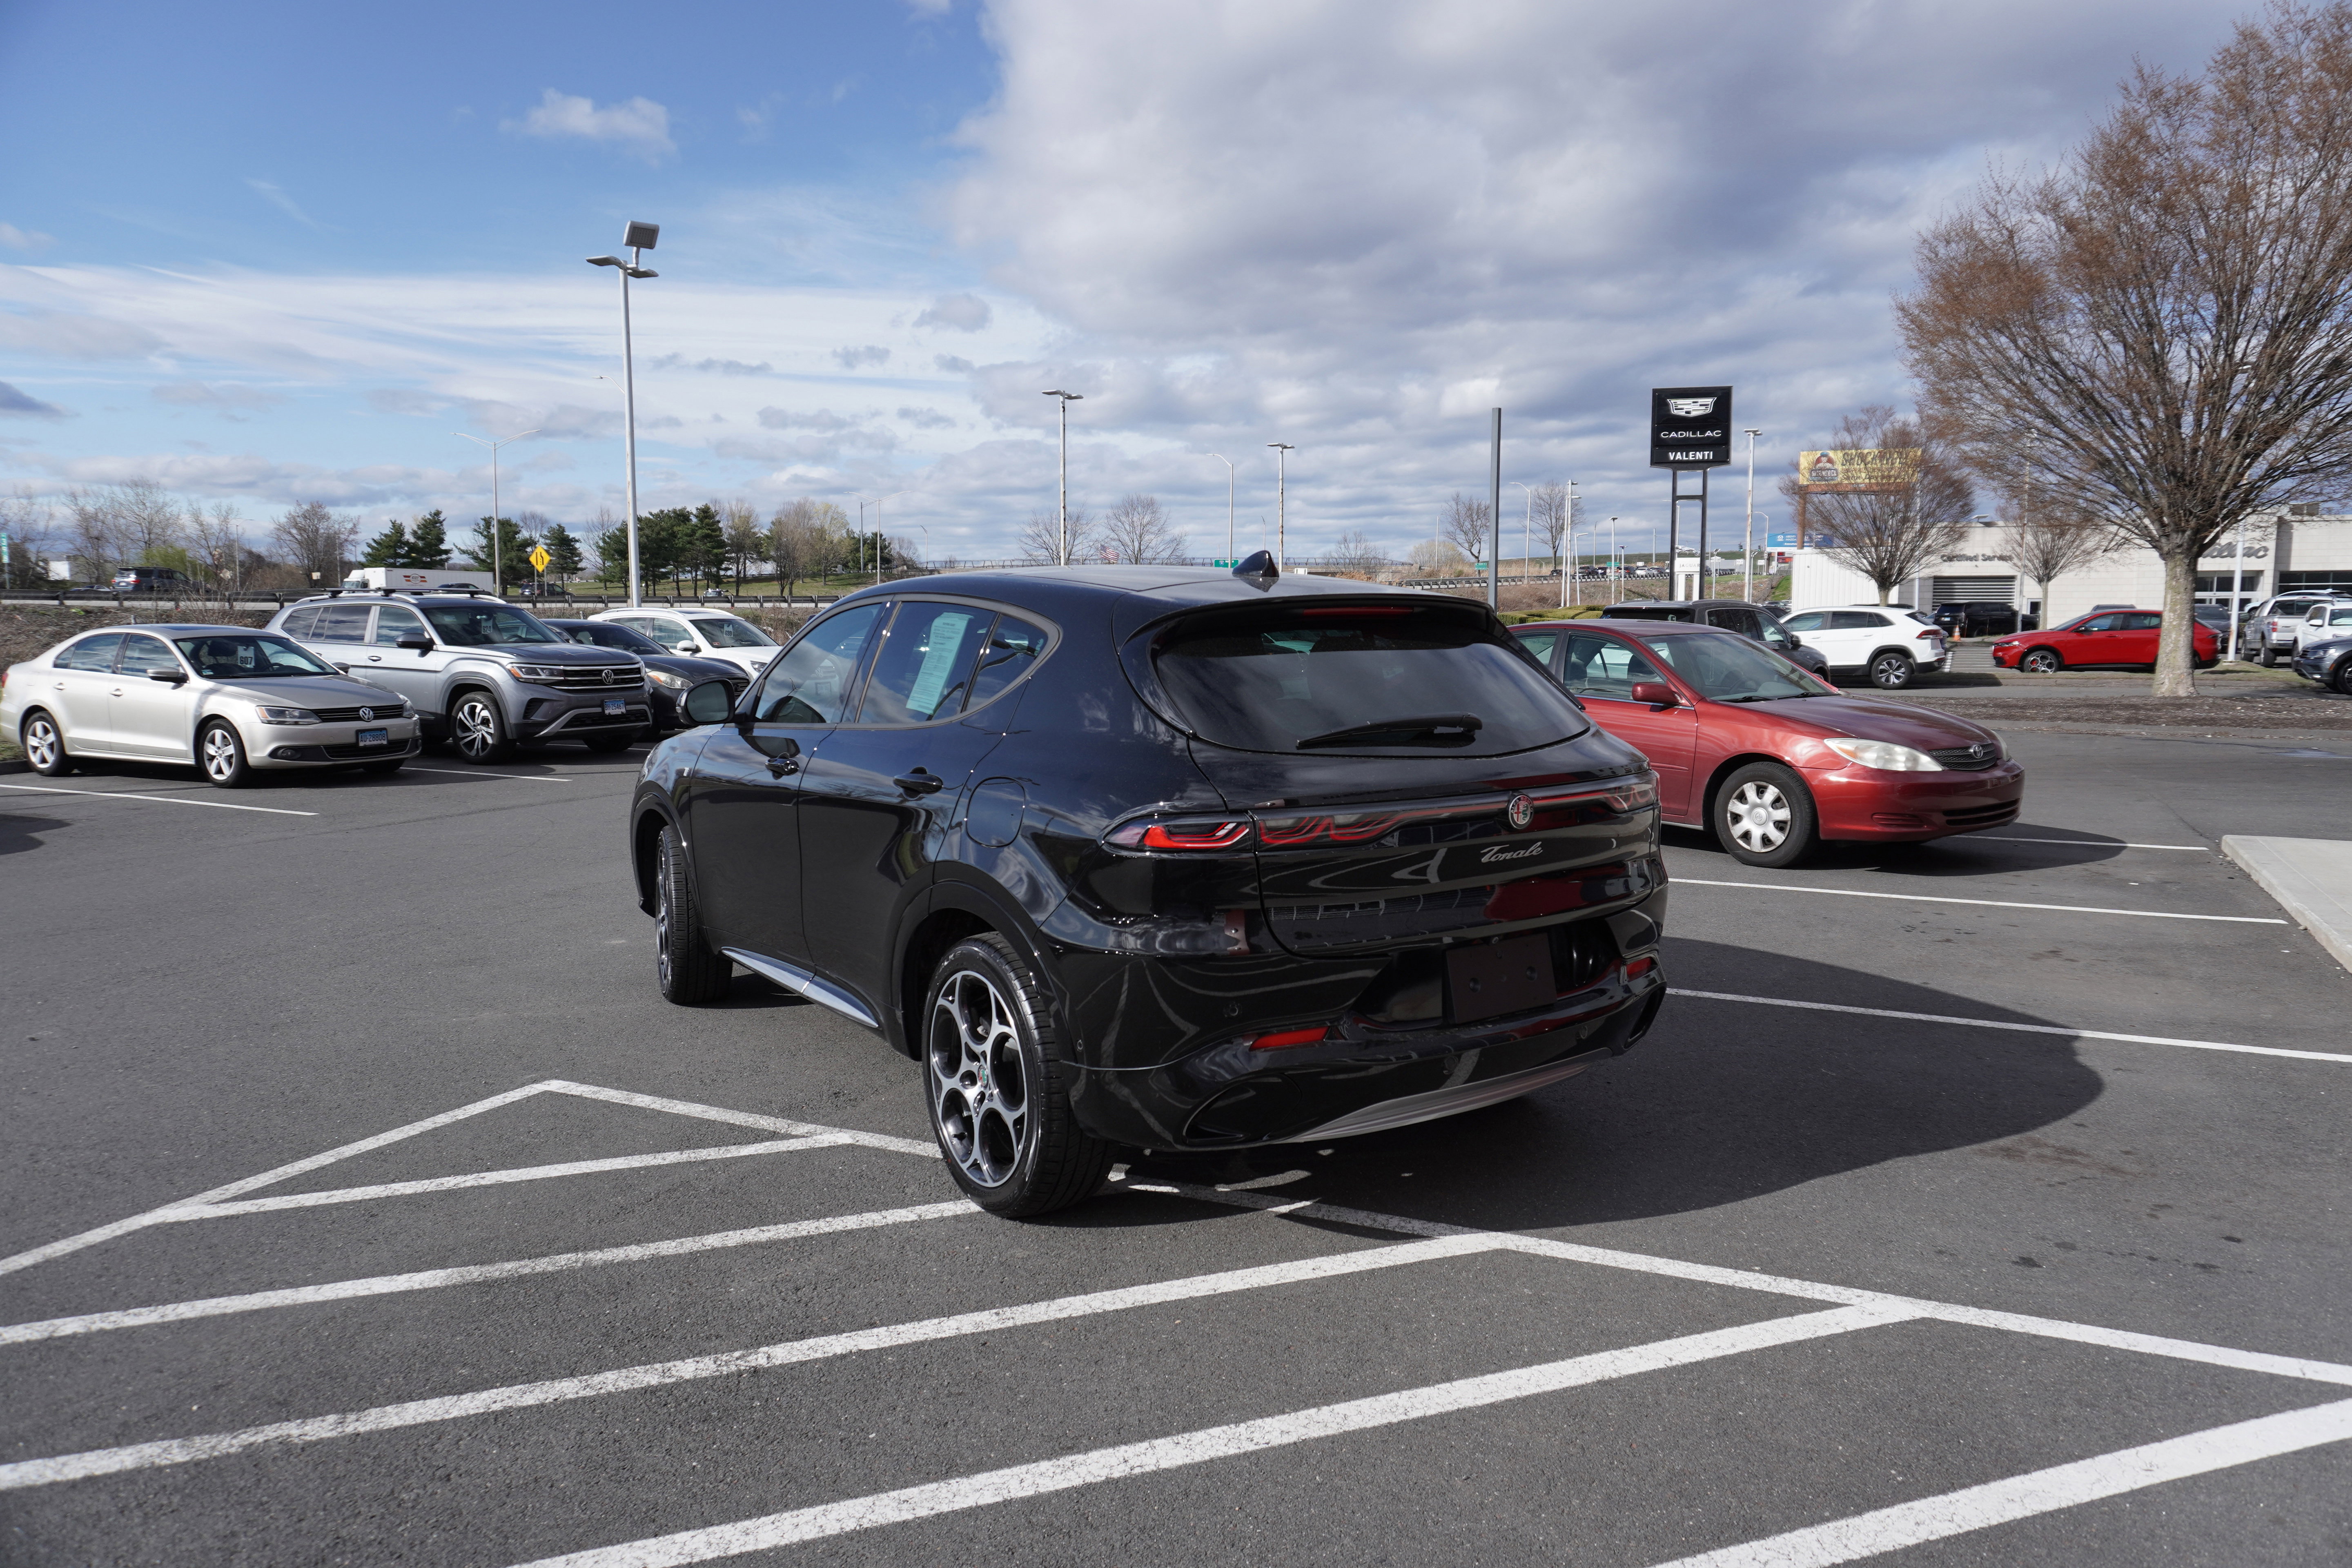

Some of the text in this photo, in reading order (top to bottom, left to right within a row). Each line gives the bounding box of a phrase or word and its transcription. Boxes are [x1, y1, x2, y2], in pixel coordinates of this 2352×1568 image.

[1669, 451, 1713, 460] VALENTI
[240, 656, 253, 665] 607
[360, 733, 385, 742] AU-28808
[1480, 841, 1543, 863] Tonale
